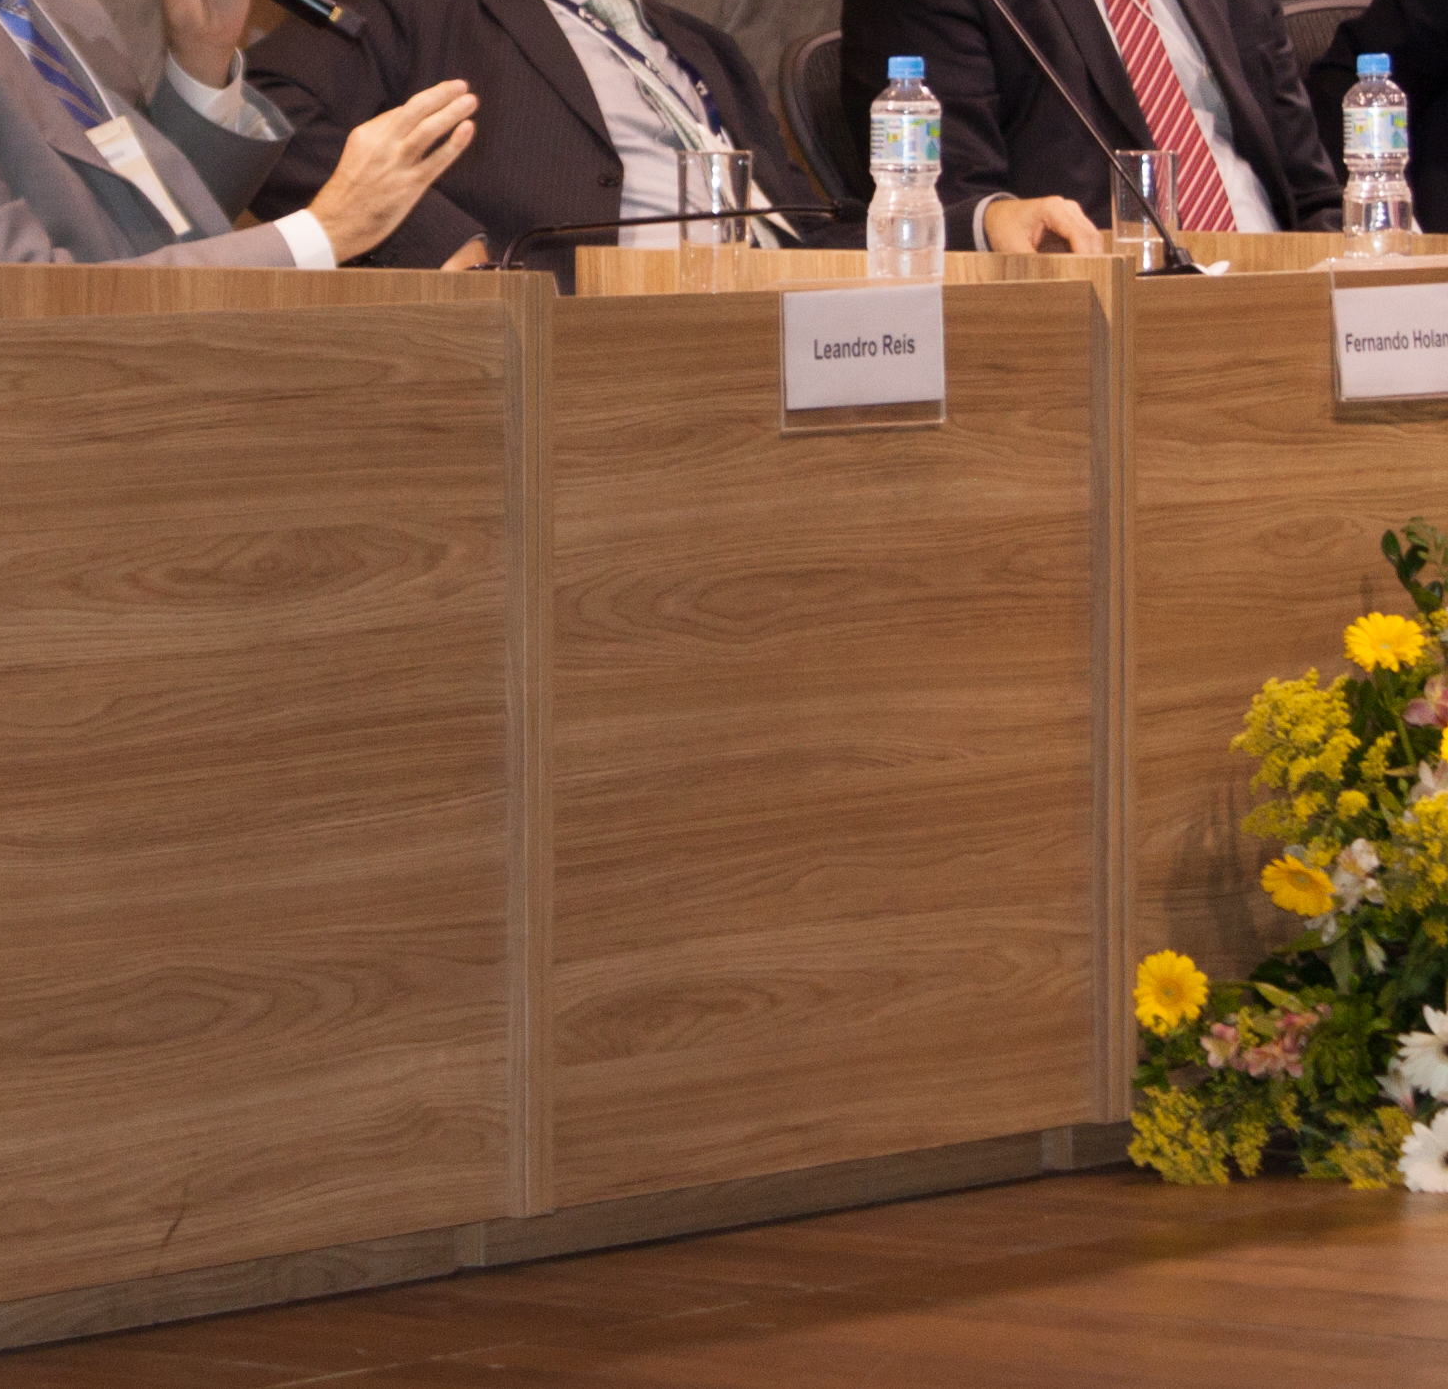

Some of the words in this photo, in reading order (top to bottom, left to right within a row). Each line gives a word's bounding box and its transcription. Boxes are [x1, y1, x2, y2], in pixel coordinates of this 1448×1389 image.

[813, 336, 877, 360] Leandro
[882, 333, 915, 355] Reis
[1345, 330, 1409, 352] Fernando
